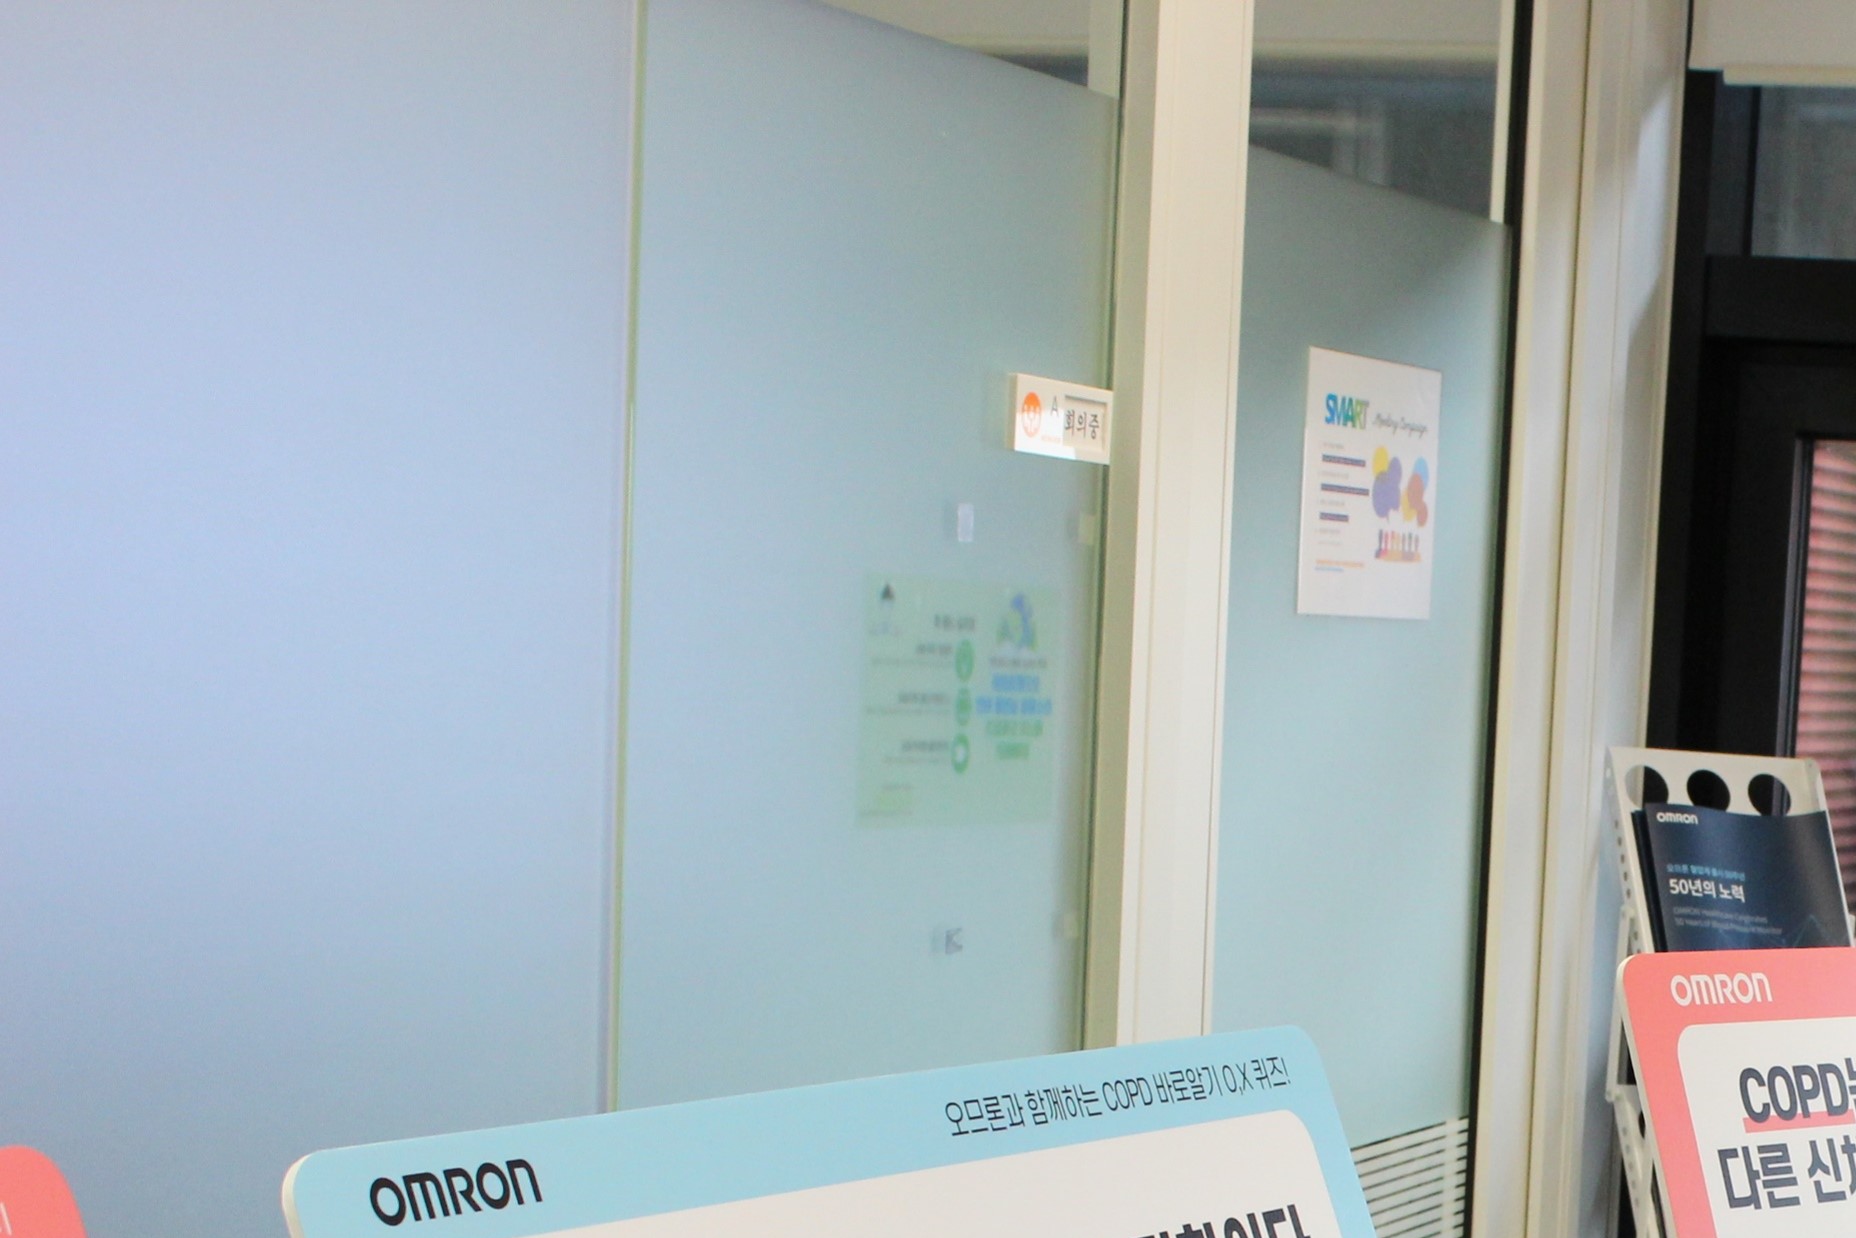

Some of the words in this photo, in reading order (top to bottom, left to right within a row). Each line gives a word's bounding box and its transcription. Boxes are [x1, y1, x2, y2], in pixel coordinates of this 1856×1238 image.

[1050, 395, 1060, 417] A
[1324, 393, 1369, 430] SMART
[1065, 409, 1100, 440] 회의중
[1656, 811, 1699, 825] OMRON
[1669, 878, 1717, 899] 50년의
[1719, 882, 1746, 904] 노력
[1670, 972, 1773, 1007] OMRON
[944, 1092, 1026, 1137] 오므론과
[1024, 1084, 1103, 1125] 함께하는
[1101, 1077, 1154, 1112] COPD
[1156, 1066, 1223, 1105] 바로알기
[1251, 1056, 1292, 1090] 퀴즈!
[369, 1158, 544, 1227] OMRON
[1717, 1142, 1801, 1210] 다른
